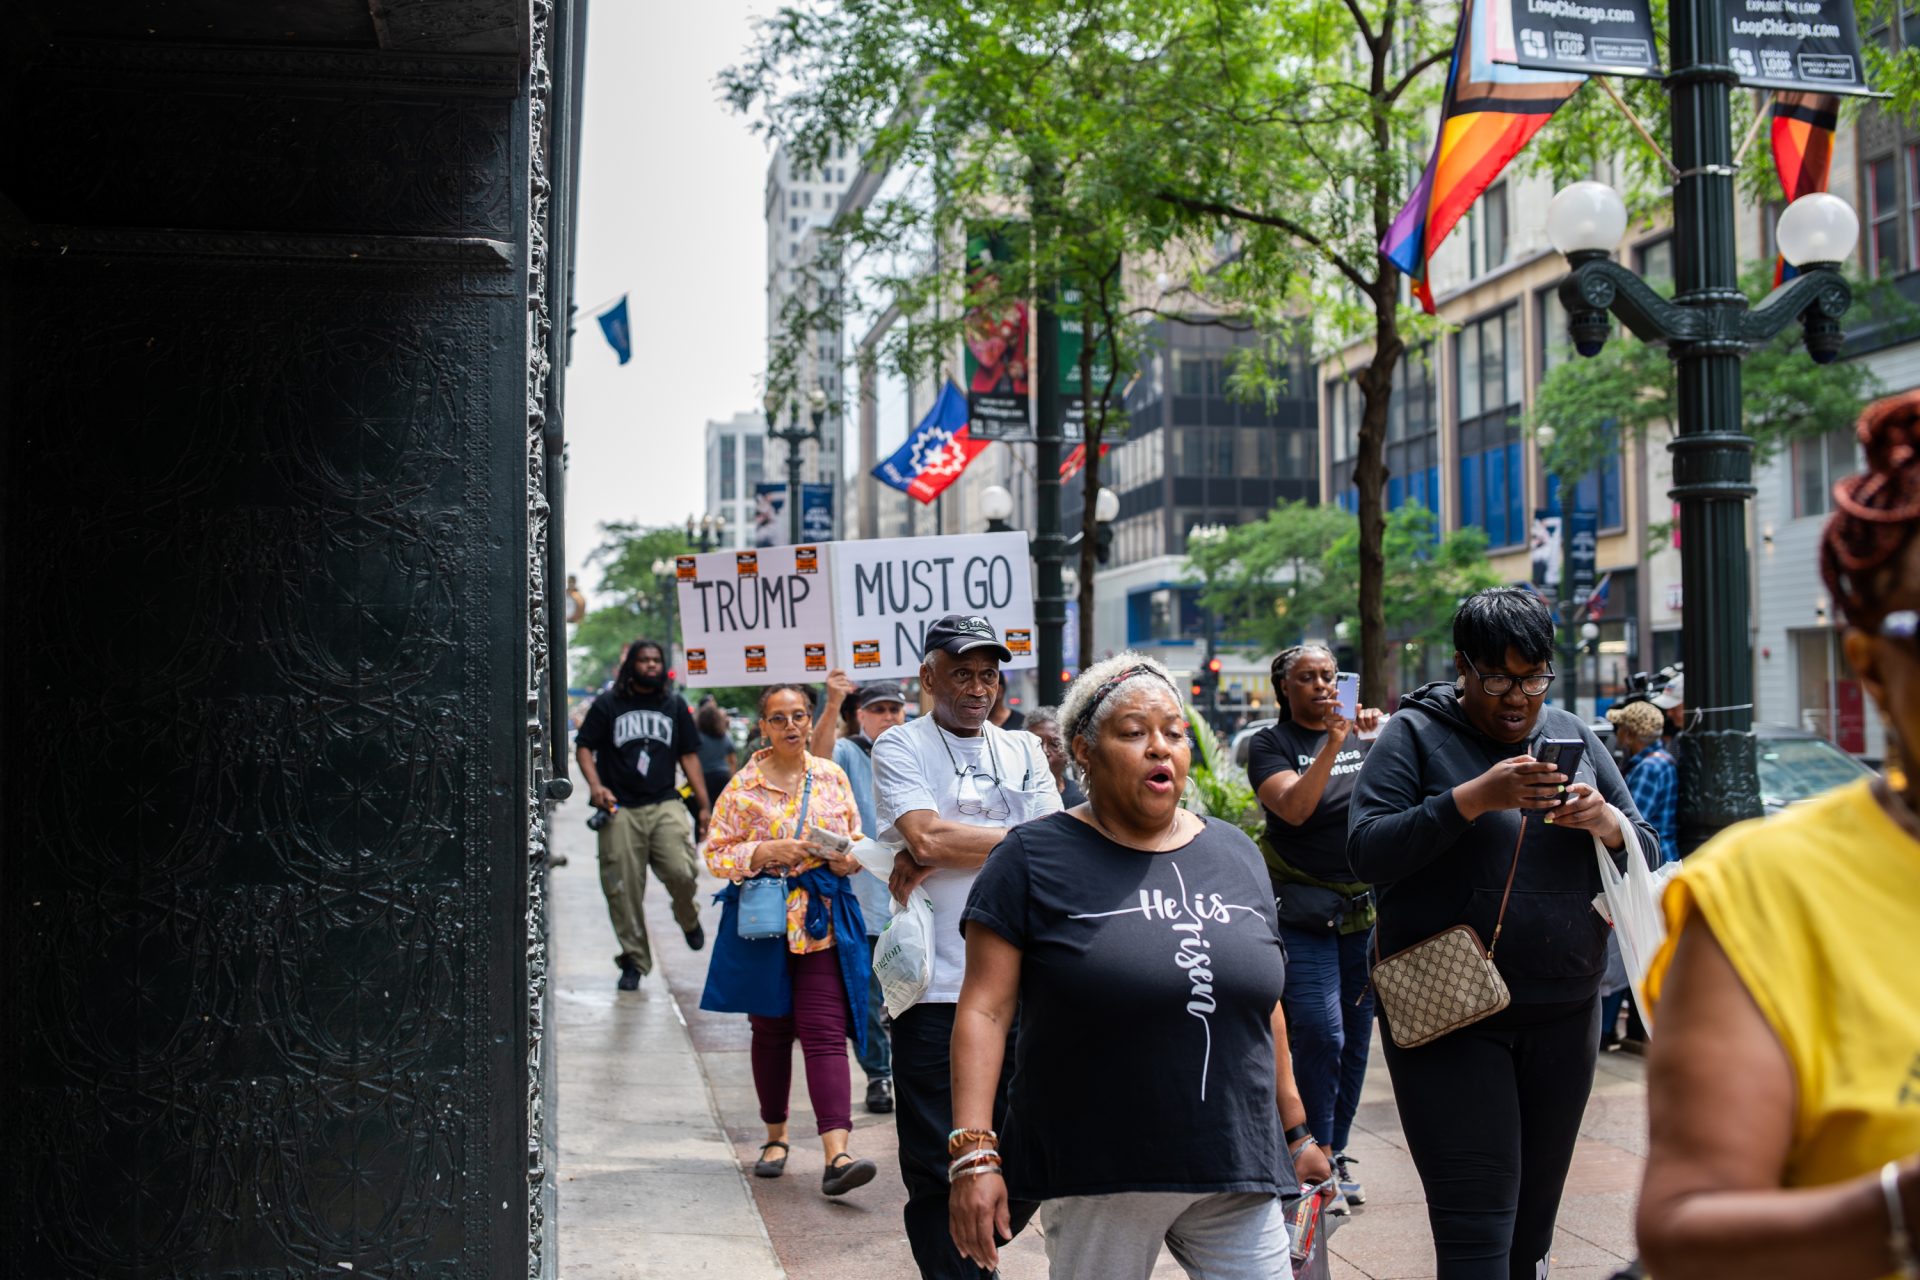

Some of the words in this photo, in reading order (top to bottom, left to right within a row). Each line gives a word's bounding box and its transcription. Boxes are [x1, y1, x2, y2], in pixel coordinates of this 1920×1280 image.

[1528, 0, 1635, 24] LoopChicago.com
[1731, 17, 1840, 39] LoopChicago.com
[1555, 40, 1586, 54] LOOP
[1762, 58, 1792, 71] LOOP
[693, 574, 810, 633] TRUMP
[855, 558, 955, 617] MUST
[962, 555, 1013, 609] GO
[614, 709, 673, 748] UNITY
[1330, 761, 1364, 776] Merc
[1139, 889, 1182, 920] He
[1194, 893, 1231, 923] is
[1172, 917, 1216, 1017] risen
